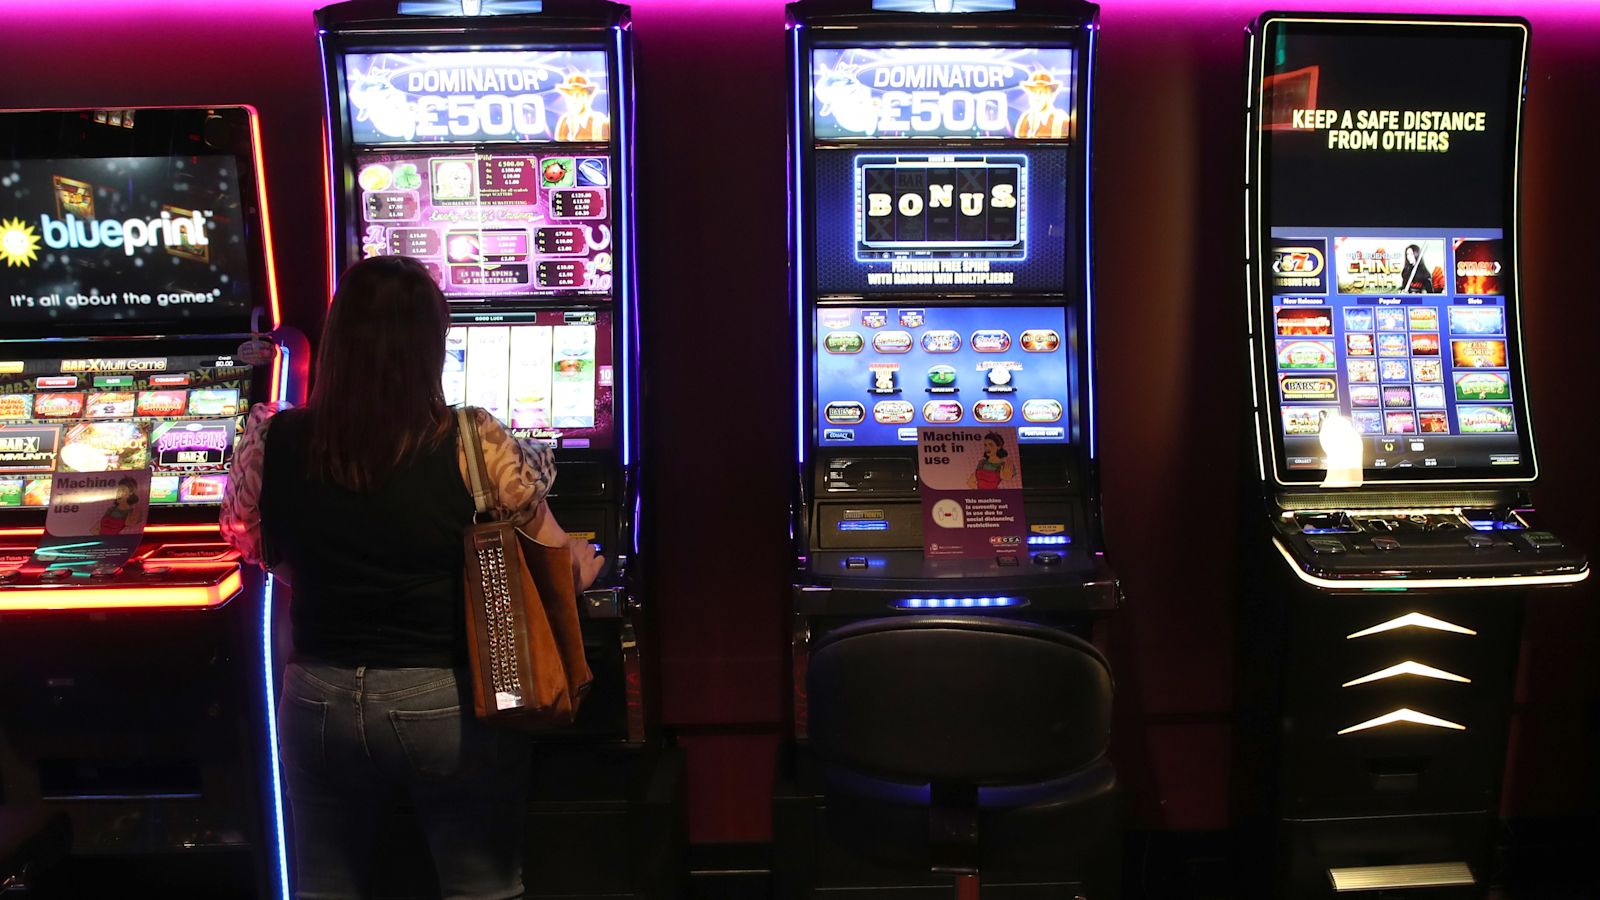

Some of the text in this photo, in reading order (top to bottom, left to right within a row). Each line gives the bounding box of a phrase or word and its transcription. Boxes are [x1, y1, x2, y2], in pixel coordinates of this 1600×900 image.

[408, 68, 540, 92] DOMINATOR
[874, 65, 1004, 88] DOMINATOR
[416, 94, 546, 136] £500
[878, 91, 1008, 131] £500
[1293, 110, 1486, 131] KEEP A SAFE DISTANCE
[1329, 130, 1449, 152] FROM OTHERS
[868, 184, 1016, 216] BONUS
[41, 210, 208, 256] blueprint
[892, 261, 990, 272] FEATURING FREE SPINS
[868, 272, 892, 284] WITH
[894, 272, 933, 284] RANDOM
[934, 272, 953, 284] WIN
[10, 292, 214, 307] It's all about the games
[62, 359, 164, 371] BAR-X Multi Game
[600, 370, 610, 380] 10
[159, 432, 196, 452] SUPER
[196, 431, 227, 450] SPINS
[923, 432, 981, 440] Machine
[924, 443, 964, 453] not in
[0, 452, 56, 460] MMUNITY
[924, 456, 950, 465] use
[57, 478, 116, 489] Machine
[54, 504, 79, 514] use
[990, 536, 1020, 544] MECCA
